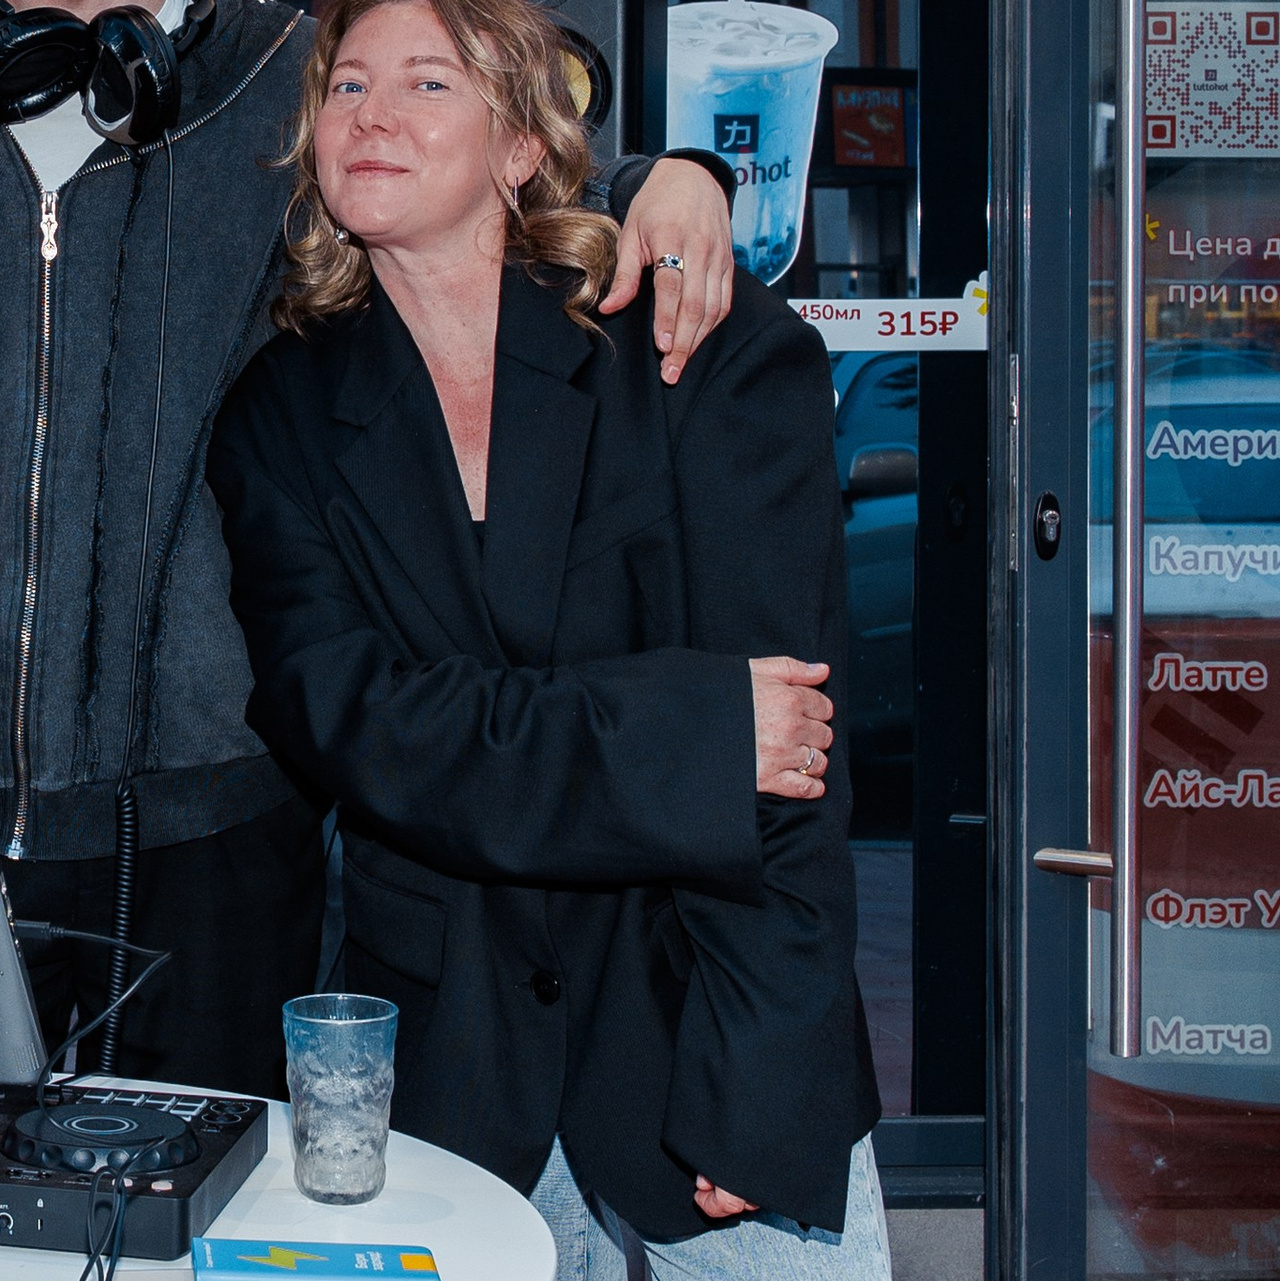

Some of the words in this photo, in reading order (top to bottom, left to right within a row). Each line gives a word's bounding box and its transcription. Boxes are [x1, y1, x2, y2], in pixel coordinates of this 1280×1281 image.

[1193, 81, 1229, 91] tuttohot
[736, 155, 792, 187] ohot
[1168, 229, 1252, 261] Цена
[1168, 284, 1227, 309] при
[1240, 284, 1278, 303] по
[877, 311, 959, 337] 315₽
[1150, 655, 1267, 690] Латте
[1149, 891, 1250, 926] Флэт
[1149, 1019, 1269, 1052] Матча
